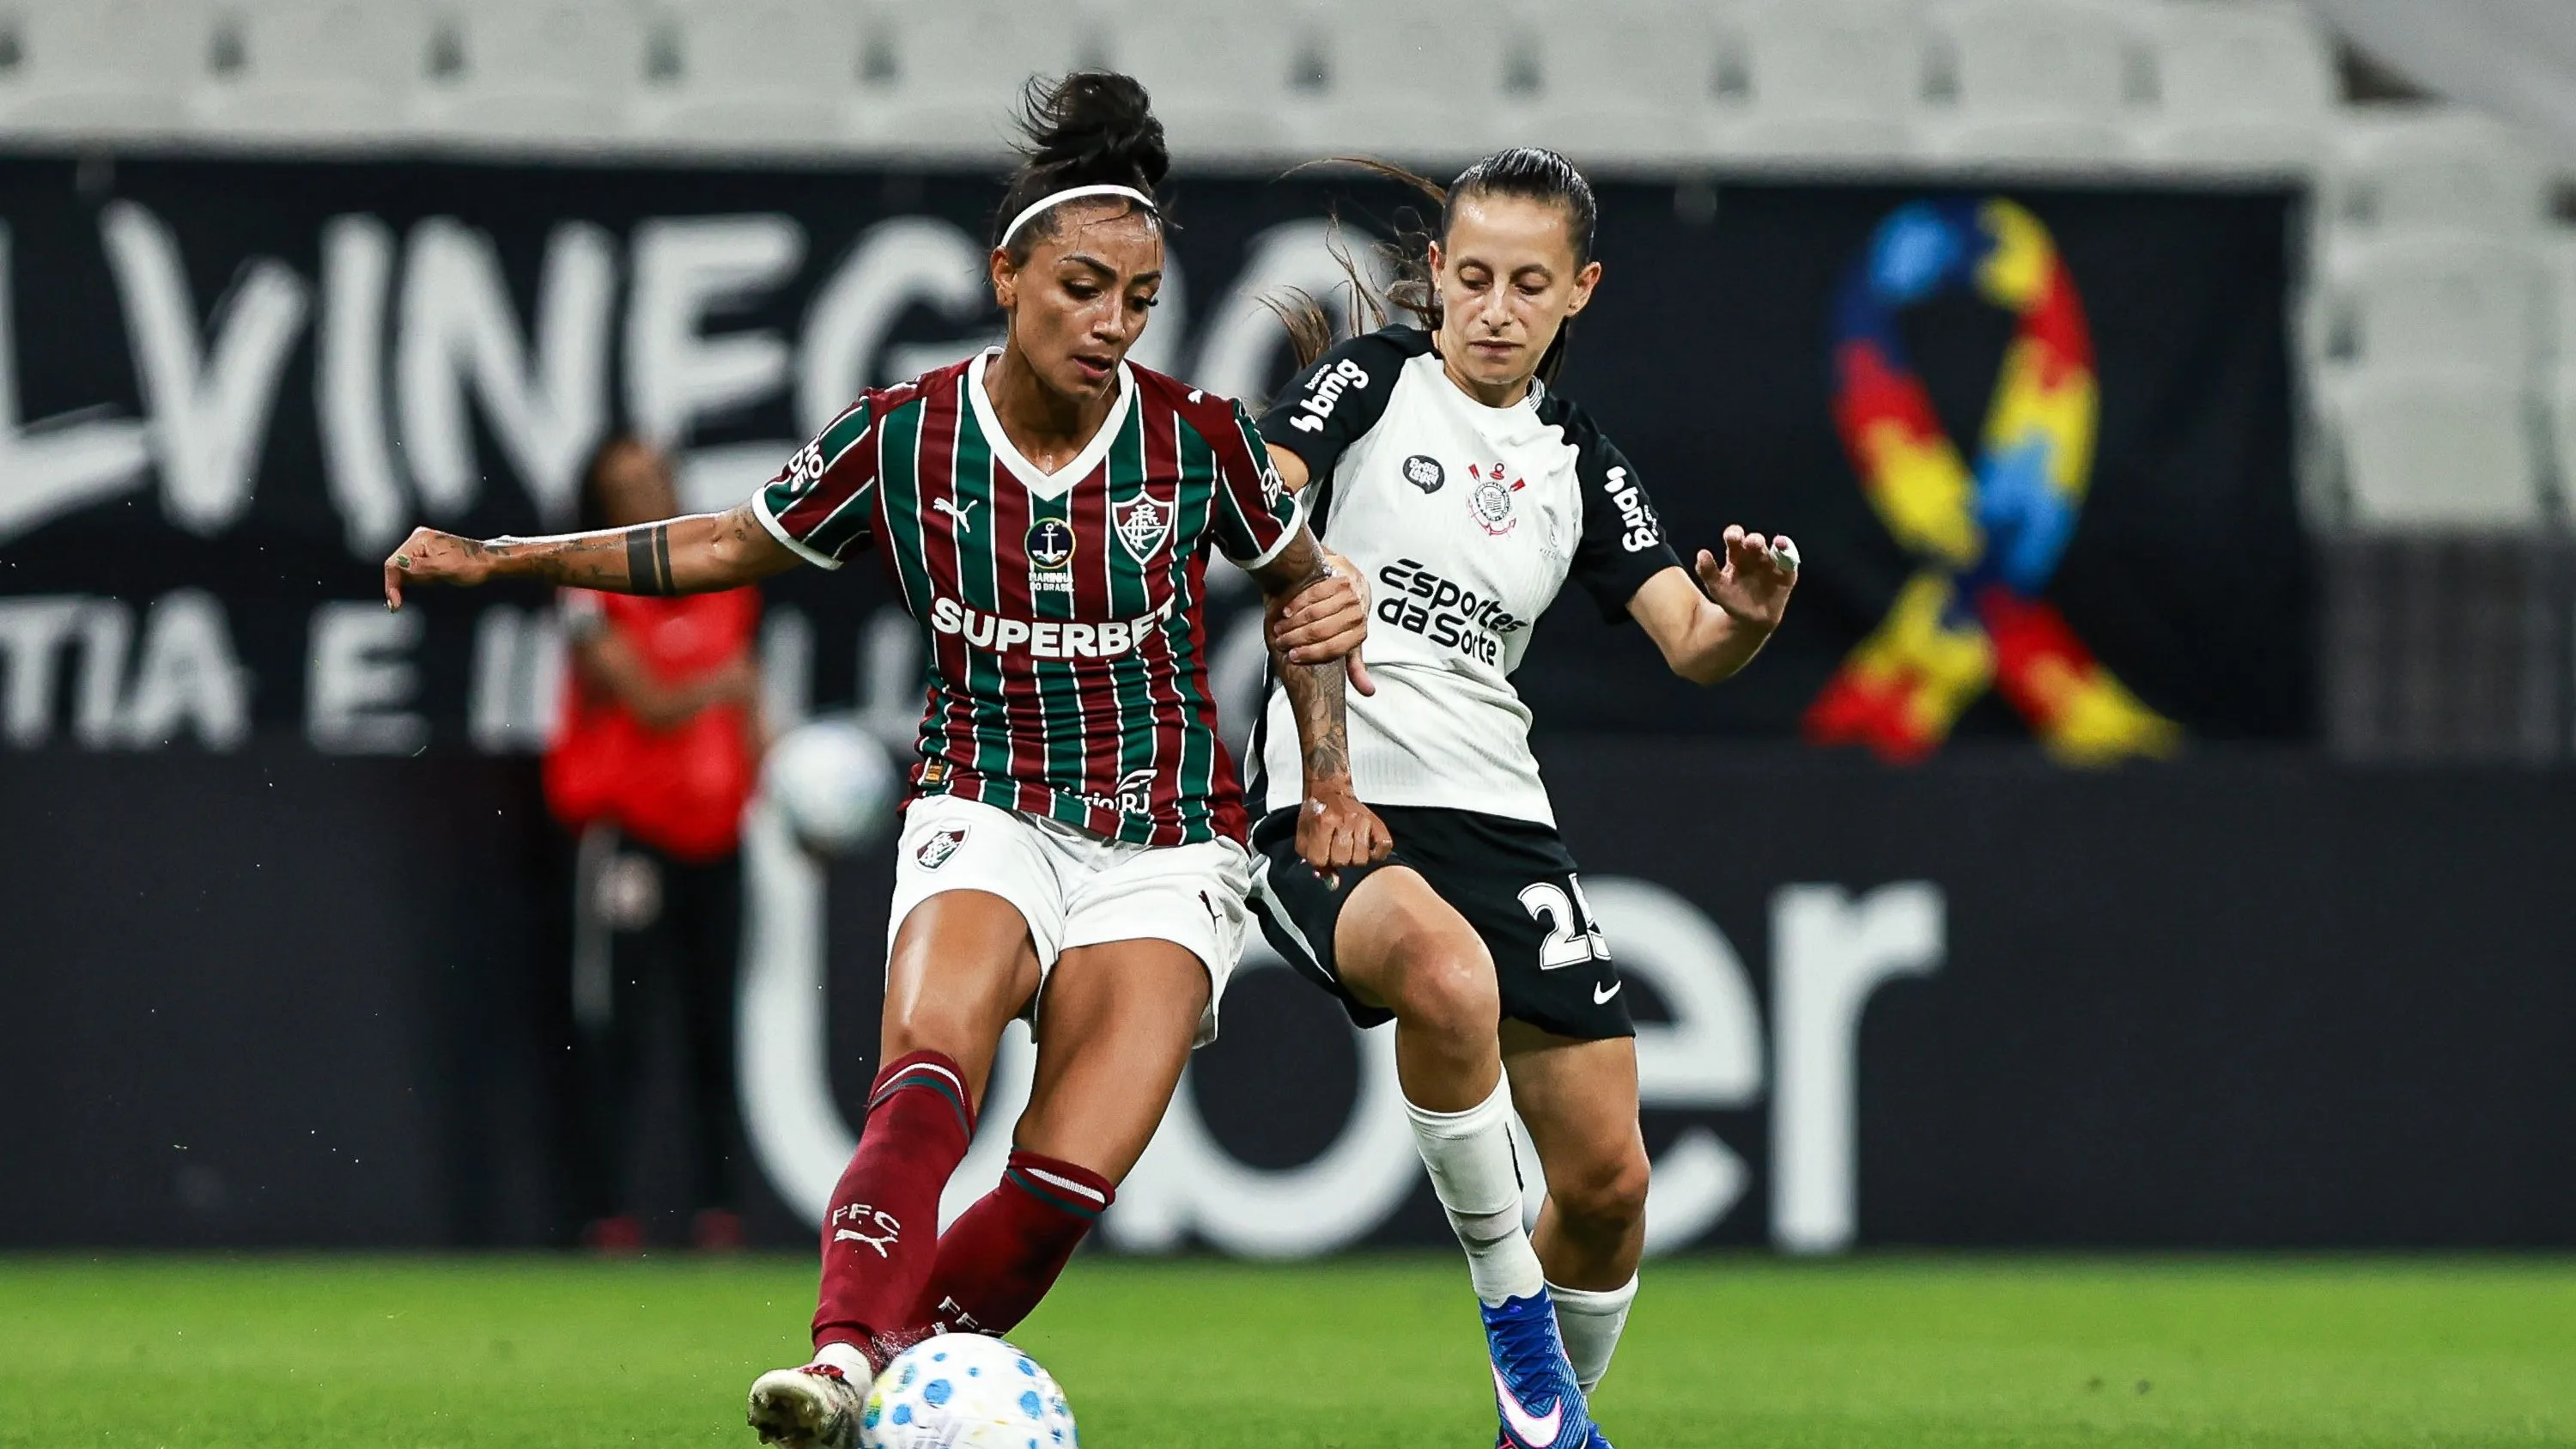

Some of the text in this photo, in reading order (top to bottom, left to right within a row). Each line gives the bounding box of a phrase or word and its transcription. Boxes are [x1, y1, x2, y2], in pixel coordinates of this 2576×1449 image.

[1299, 358, 1369, 418] bmg
[1613, 486, 1659, 552] bmg
[931, 593, 1176, 658] SUPERBET
[1379, 558, 1528, 632] Esportes
[832, 1203, 900, 1235] FFC
[938, 1295, 1005, 1334] FF
